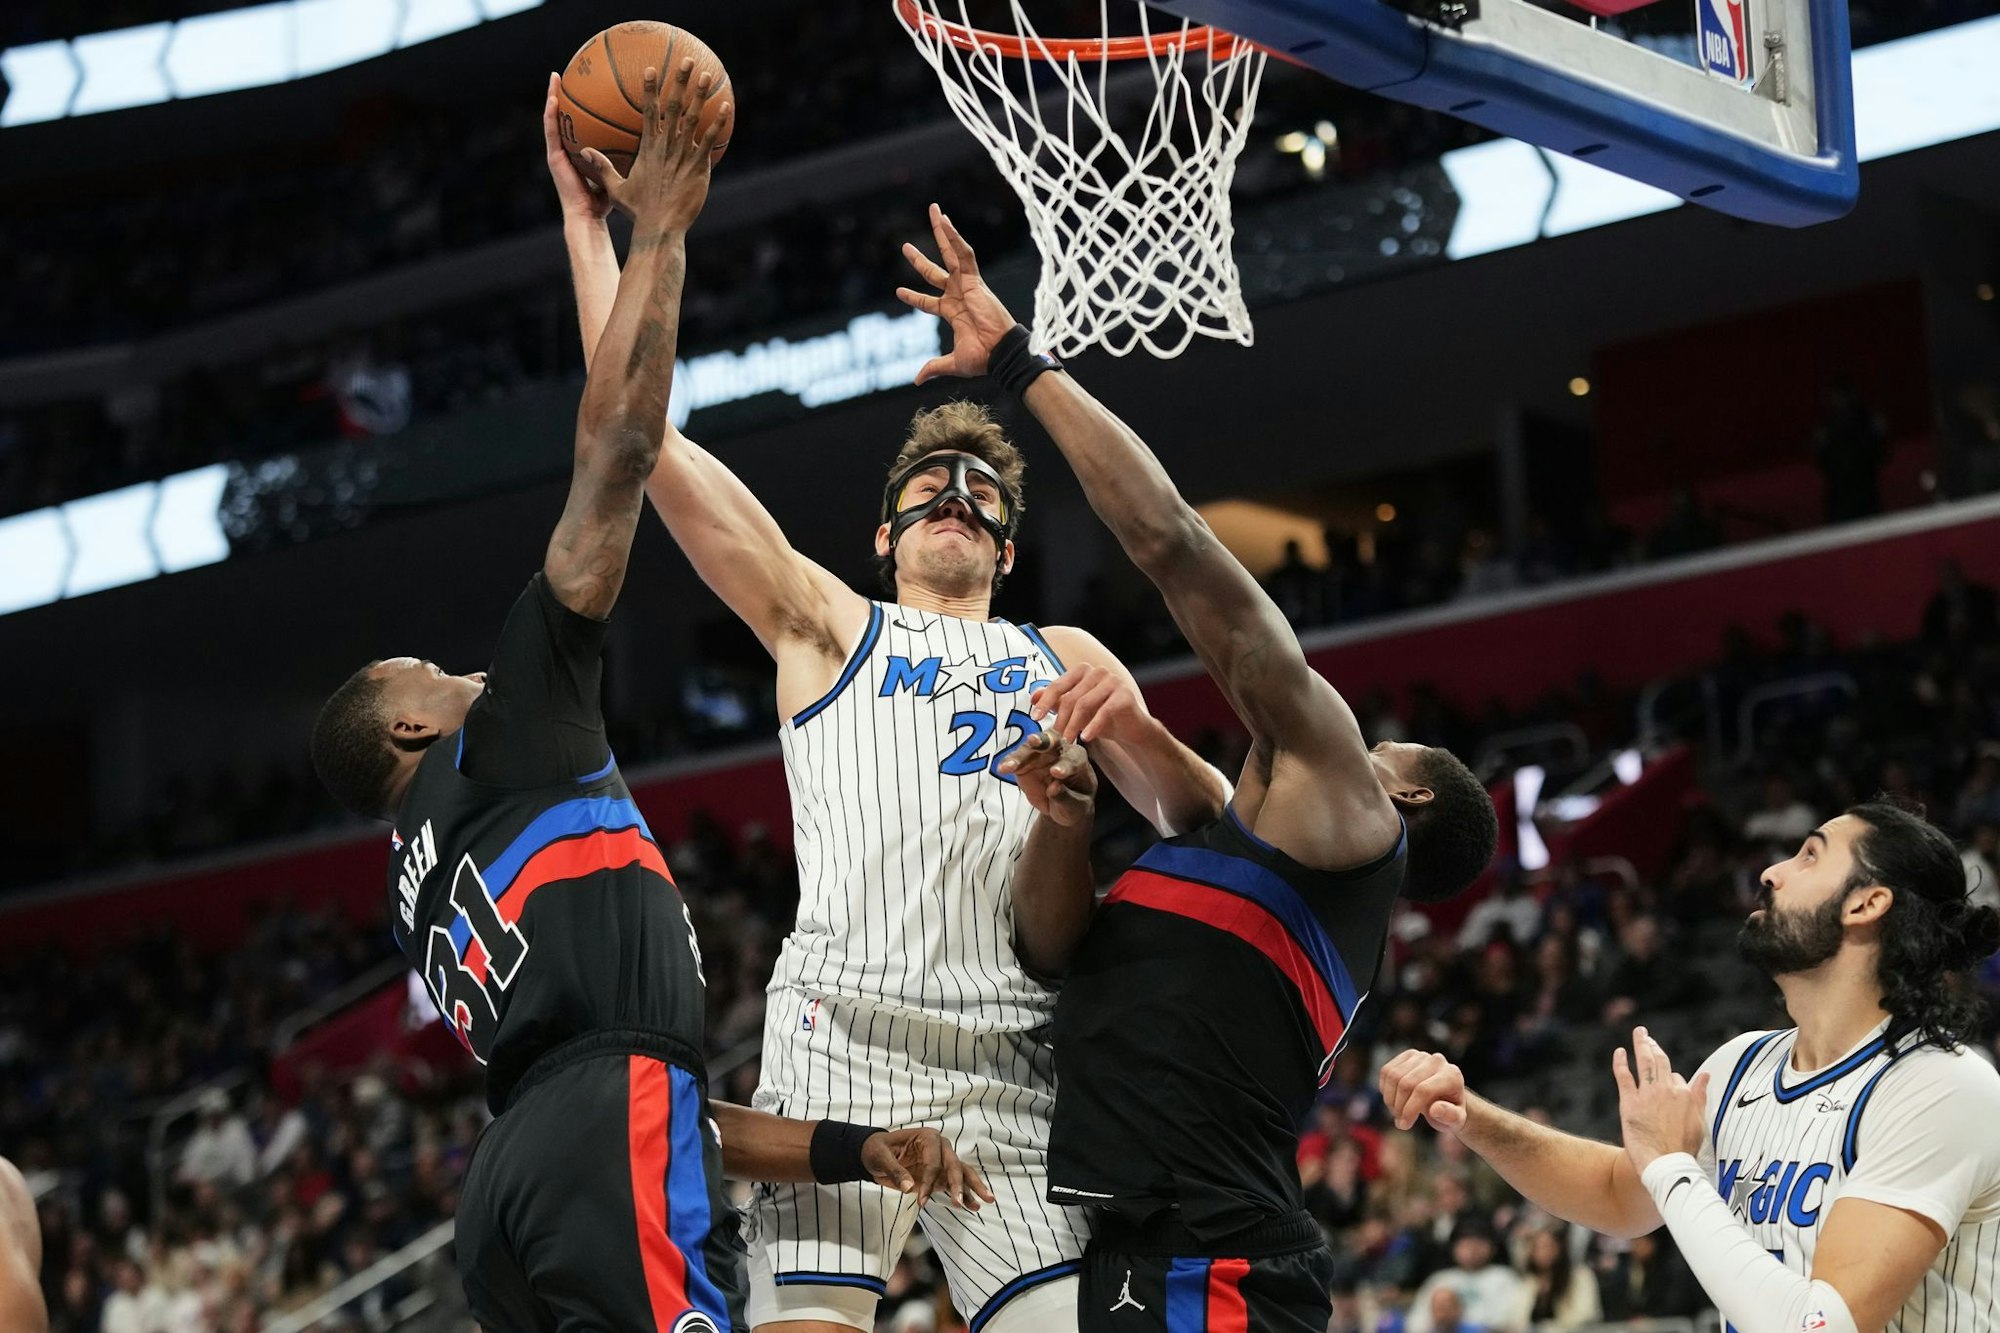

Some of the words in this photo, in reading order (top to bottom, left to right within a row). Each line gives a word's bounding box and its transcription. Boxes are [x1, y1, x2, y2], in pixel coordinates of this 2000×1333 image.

[1705, 30, 1730, 68] NBA
[939, 709, 1042, 786] 22
[398, 818, 438, 935] GREEN
[425, 852, 529, 1066] 31
